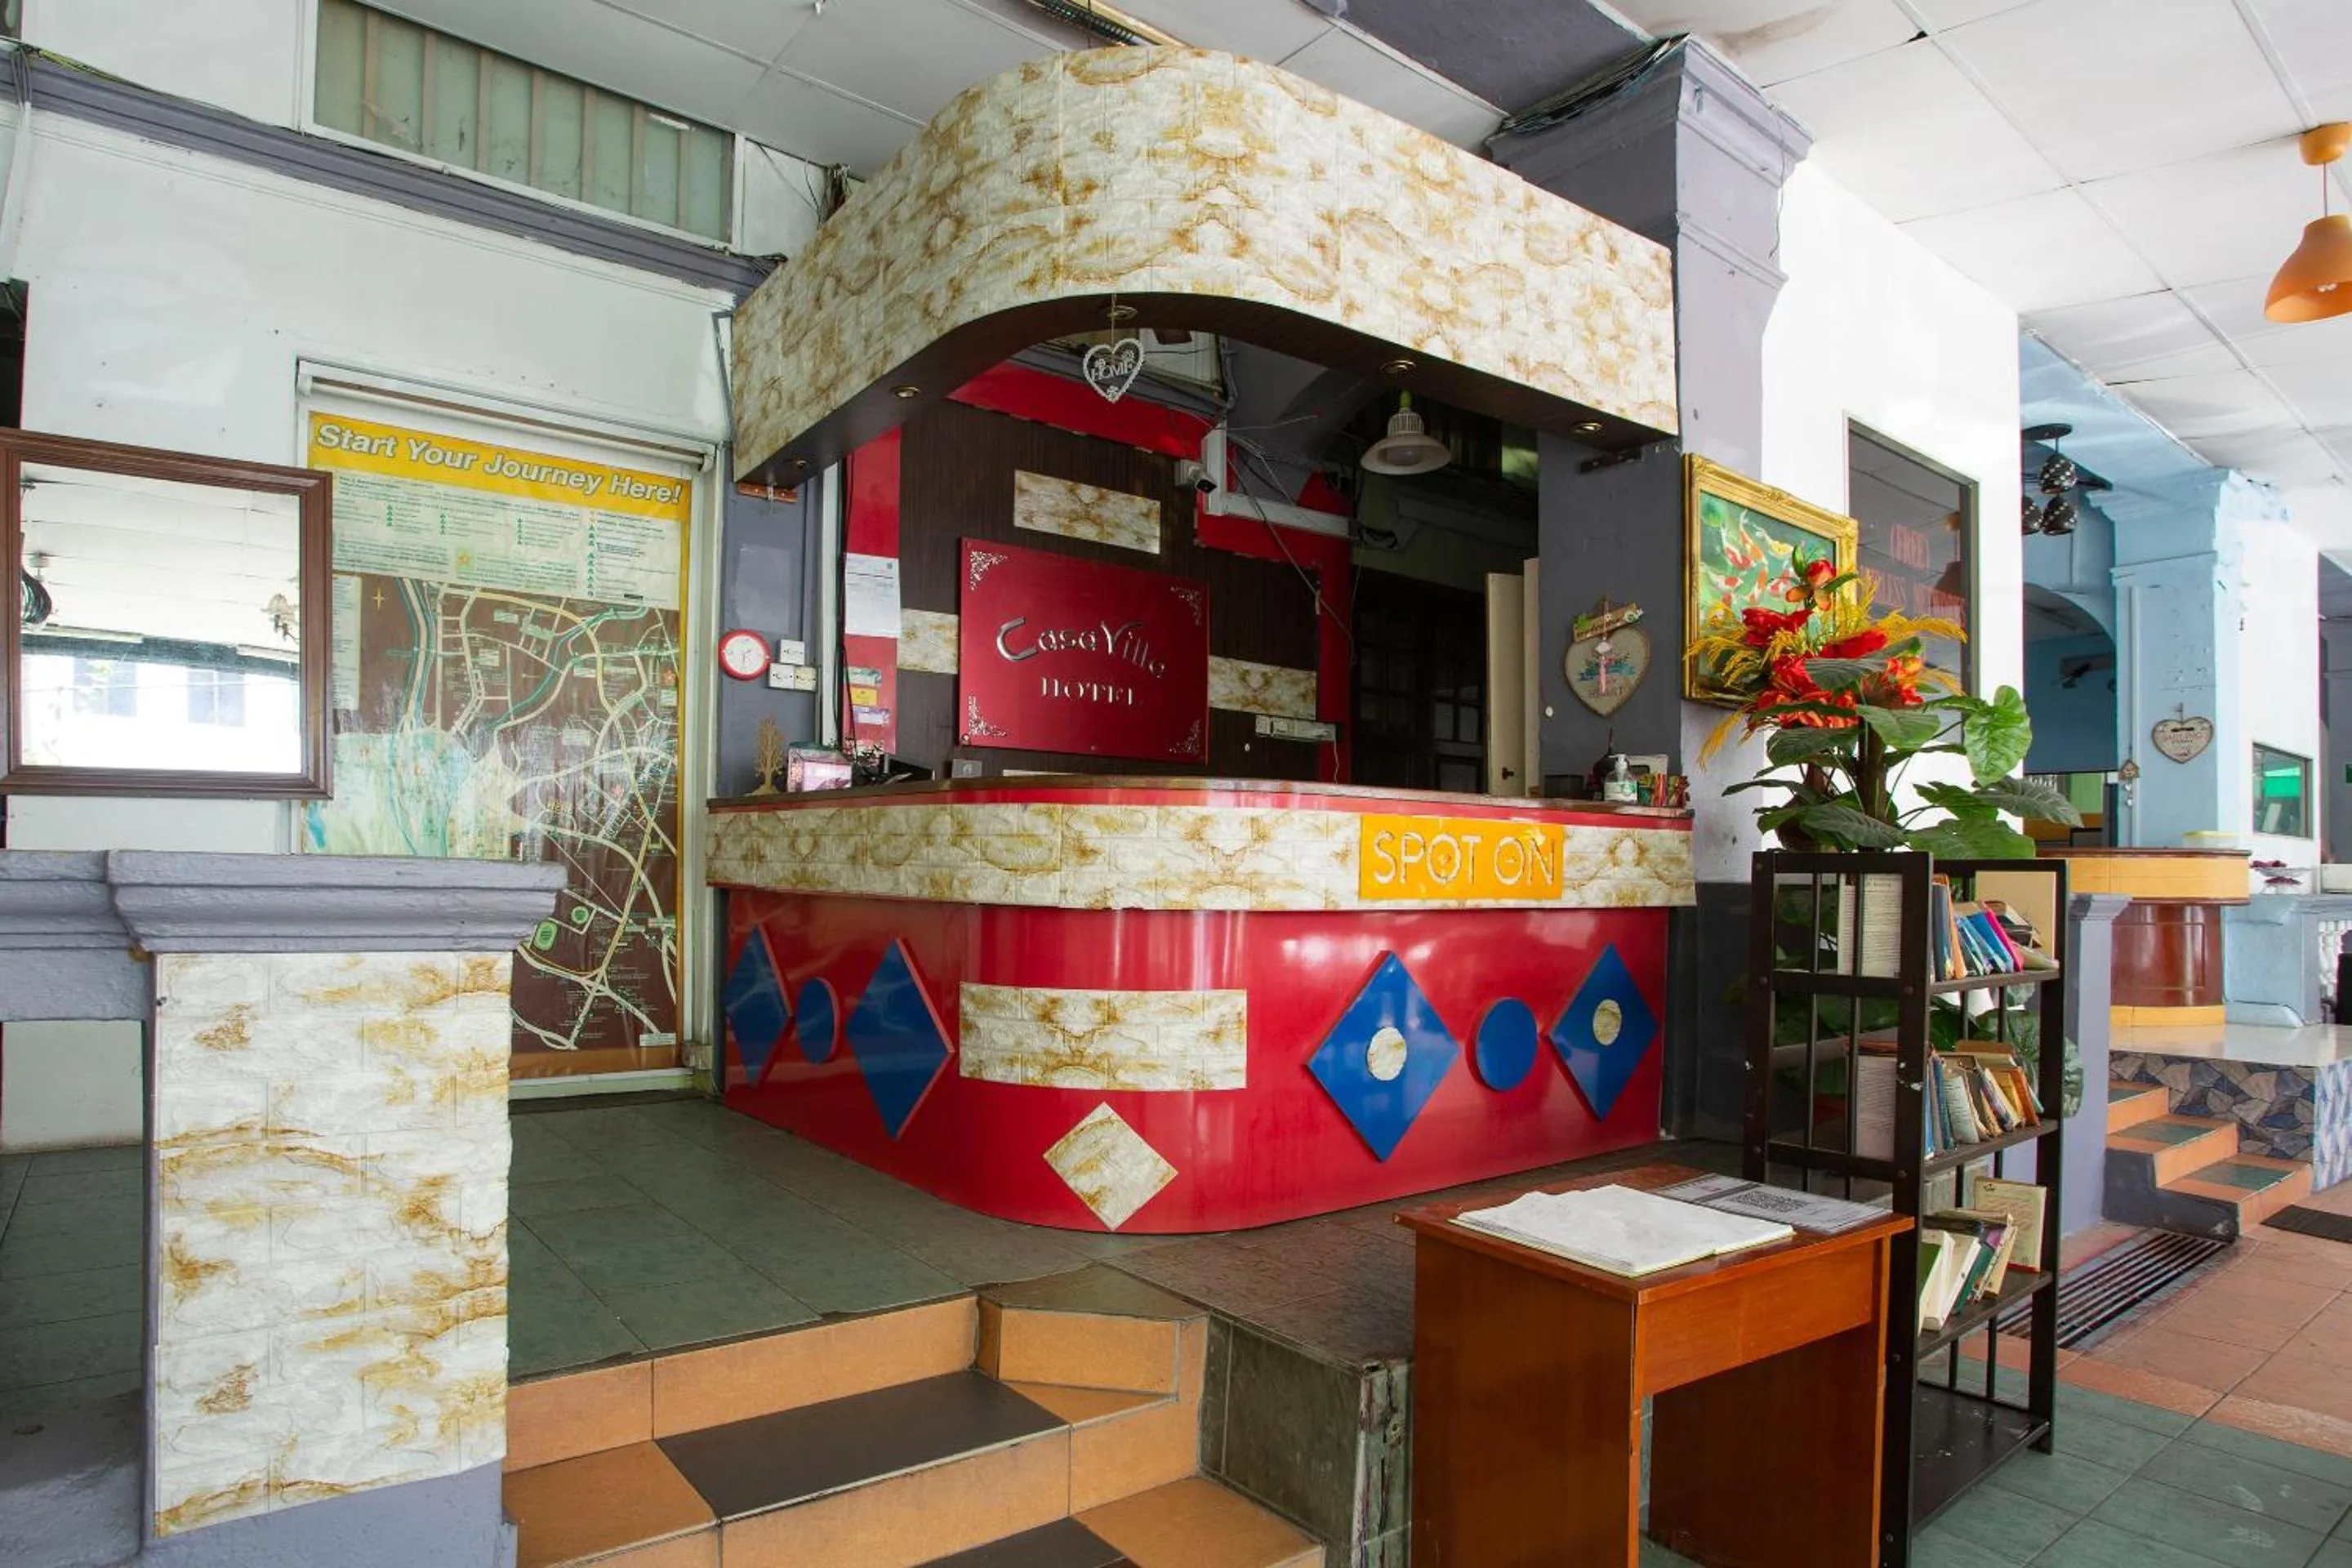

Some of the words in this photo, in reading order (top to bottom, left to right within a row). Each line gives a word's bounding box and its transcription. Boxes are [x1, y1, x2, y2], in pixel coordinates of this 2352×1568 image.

[317, 423, 398, 457] Start
[407, 437, 479, 471] Your
[483, 454, 603, 496] Journey
[608, 474, 683, 505] Here!
[1040, 677, 1135, 706] HOTEL
[1374, 830, 1484, 886] SPOT
[1494, 835, 1556, 886] ON
